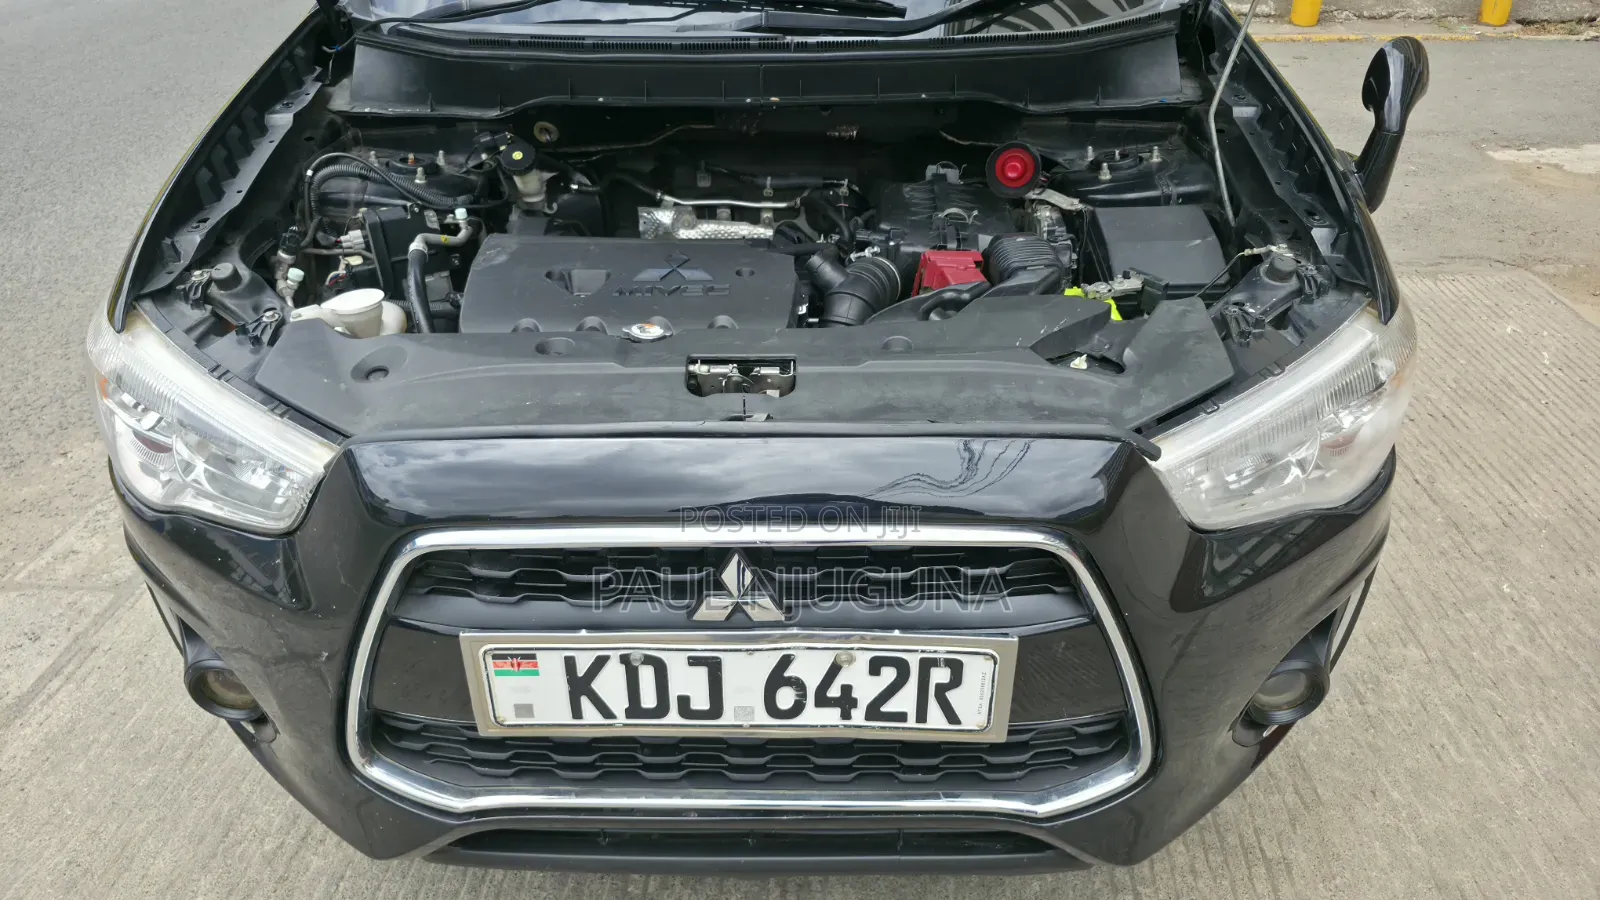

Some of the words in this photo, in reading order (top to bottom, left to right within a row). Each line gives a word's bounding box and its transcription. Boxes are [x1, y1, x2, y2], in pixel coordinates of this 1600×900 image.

[613, 283, 731, 297] MIVEC
[563, 653, 724, 720] KDJ
[763, 653, 964, 725] 642R
